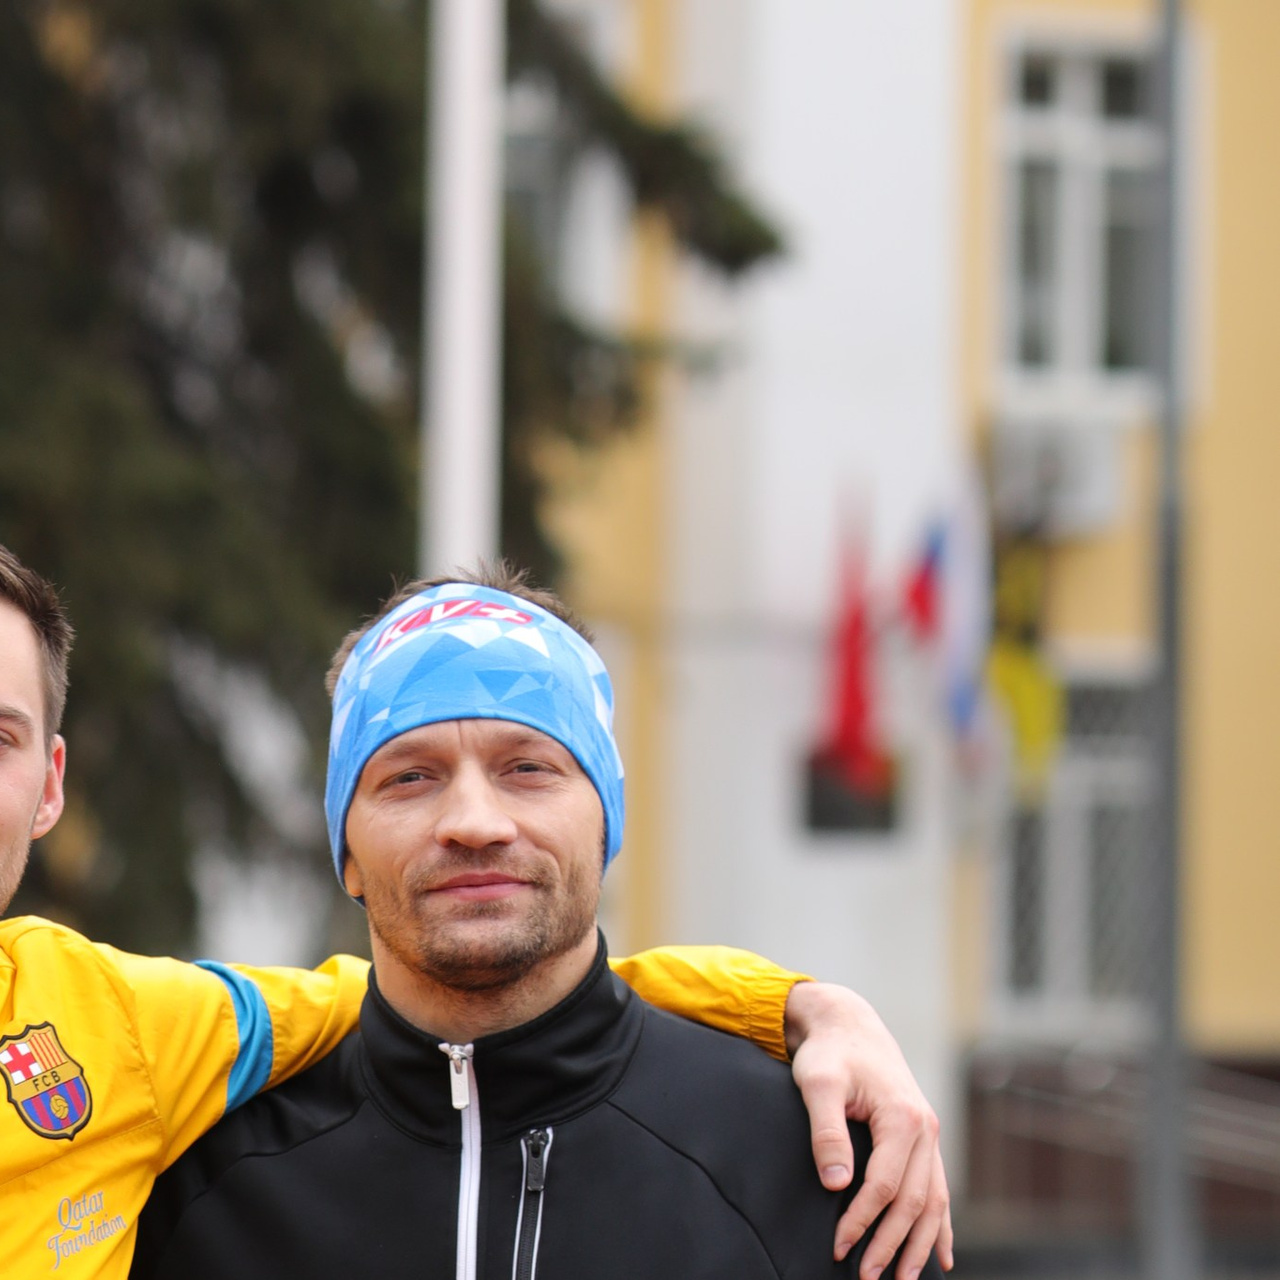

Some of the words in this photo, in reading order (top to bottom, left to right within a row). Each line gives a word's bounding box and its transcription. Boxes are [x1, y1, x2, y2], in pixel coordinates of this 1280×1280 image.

[32, 1070, 61, 1092] FCB
[57, 1189, 104, 1231] Qatar
[46, 1213, 127, 1271] Foundation
